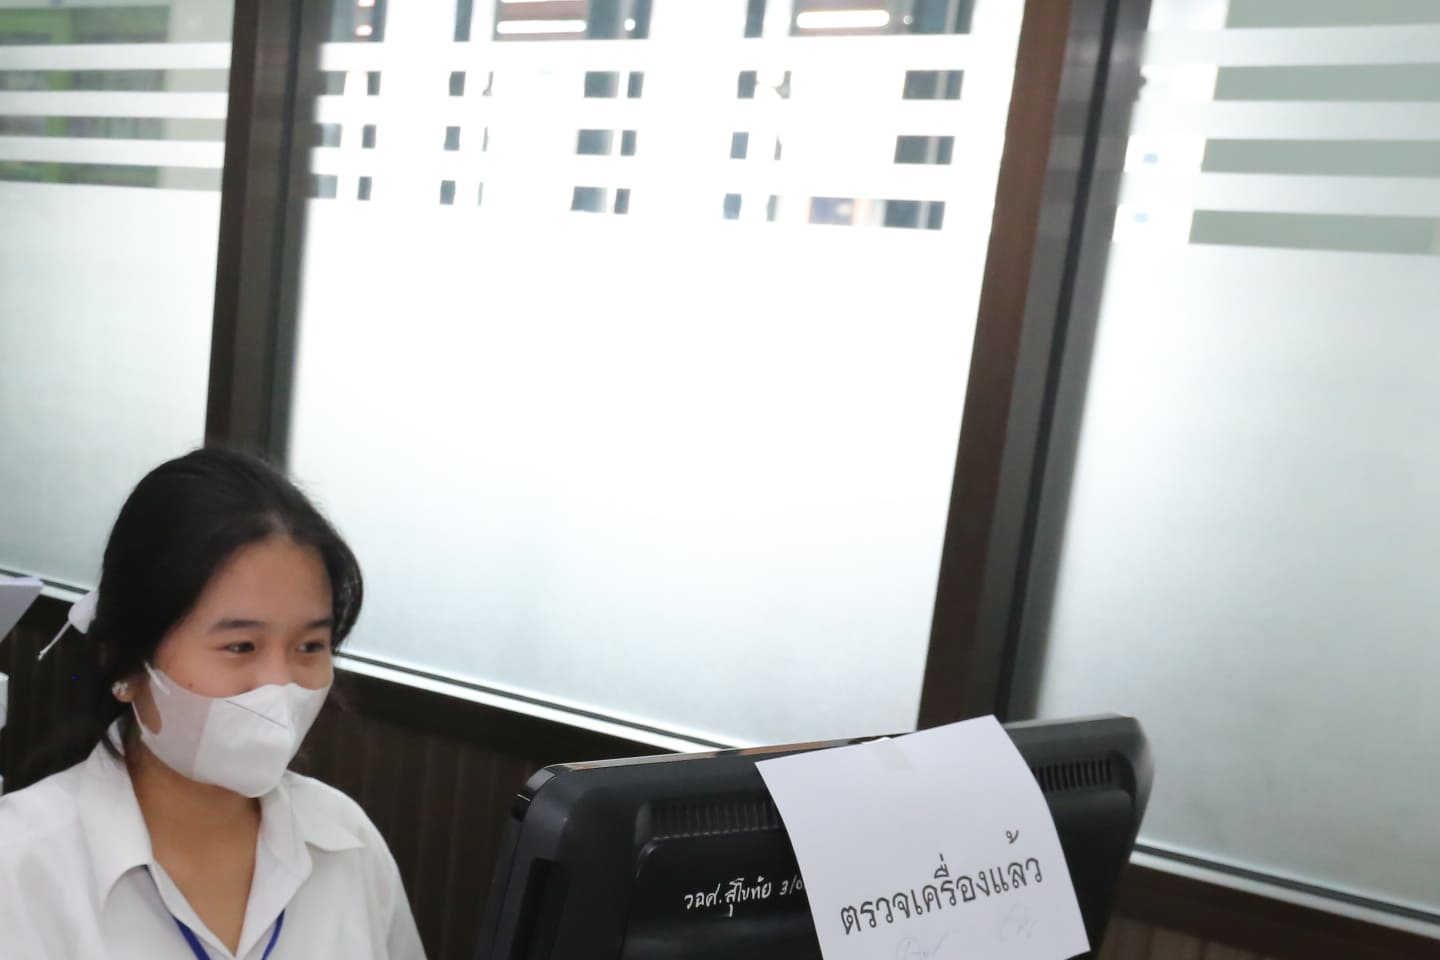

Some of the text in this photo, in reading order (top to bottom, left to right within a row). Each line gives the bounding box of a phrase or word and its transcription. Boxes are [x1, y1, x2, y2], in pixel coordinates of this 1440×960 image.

[839, 830, 1043, 935] ตรวจเครื่องแล้ว
